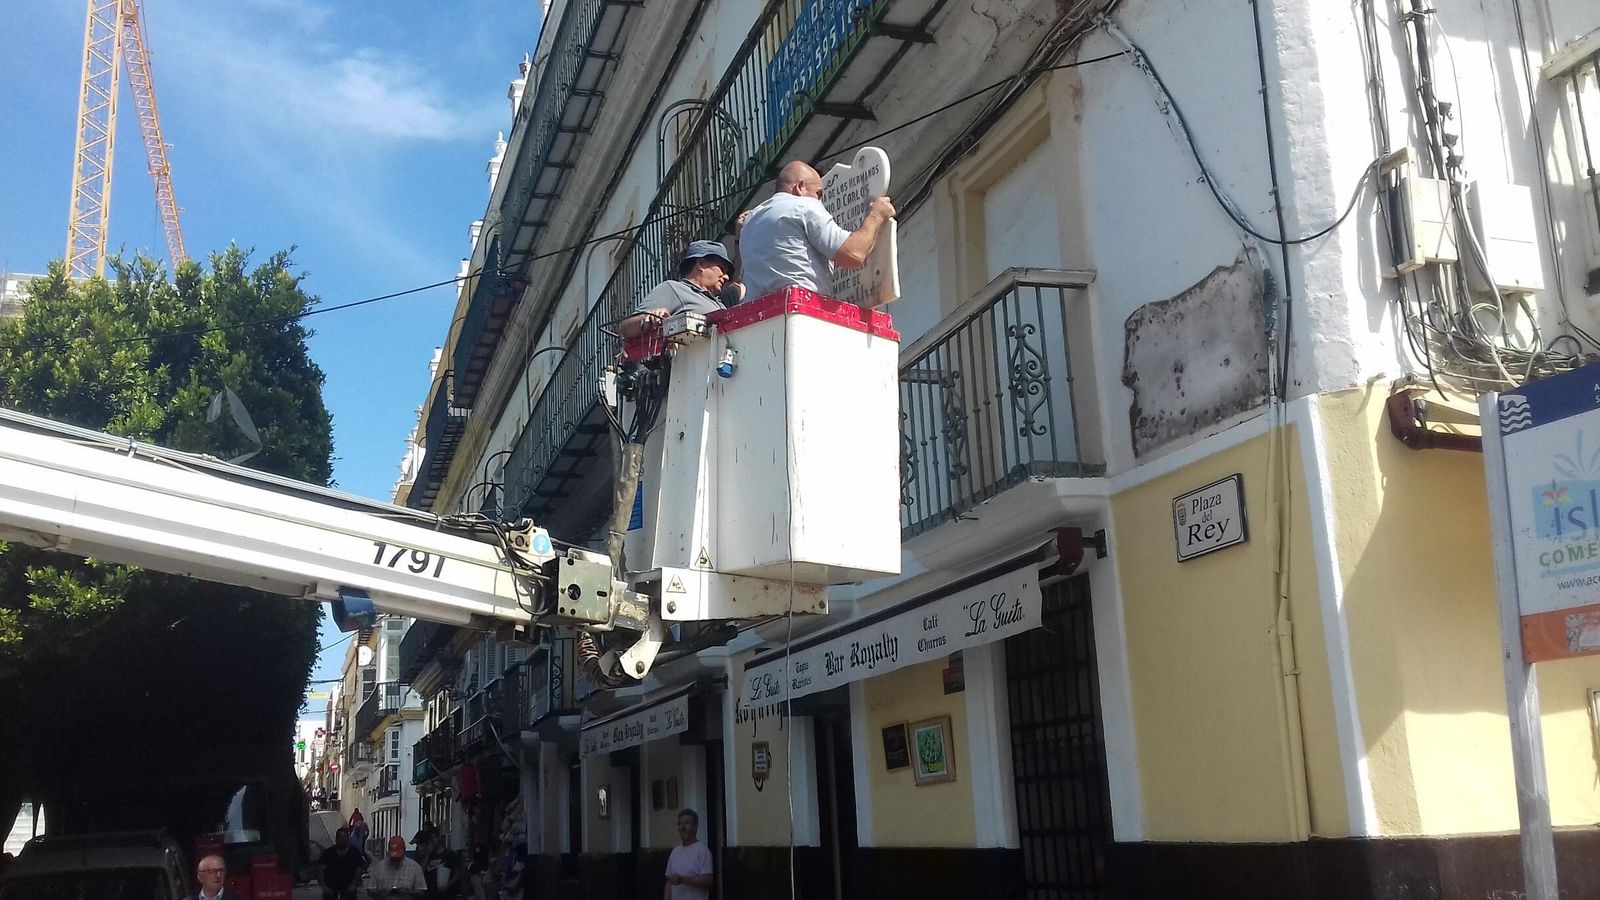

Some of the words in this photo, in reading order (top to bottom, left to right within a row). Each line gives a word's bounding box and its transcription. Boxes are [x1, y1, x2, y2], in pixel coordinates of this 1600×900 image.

[836, 181, 848, 194] LOS
[849, 164, 880, 188] HERMANOS
[842, 184, 870, 207] CARLOS
[1192, 493, 1222, 515] Plaza
[1202, 509, 1213, 524] del
[1186, 518, 1231, 547] Rey
[374, 542, 446, 578] 1791
[825, 651, 844, 677] Bar
[850, 633, 898, 670] Royalty
[917, 635, 947, 653] Churros
